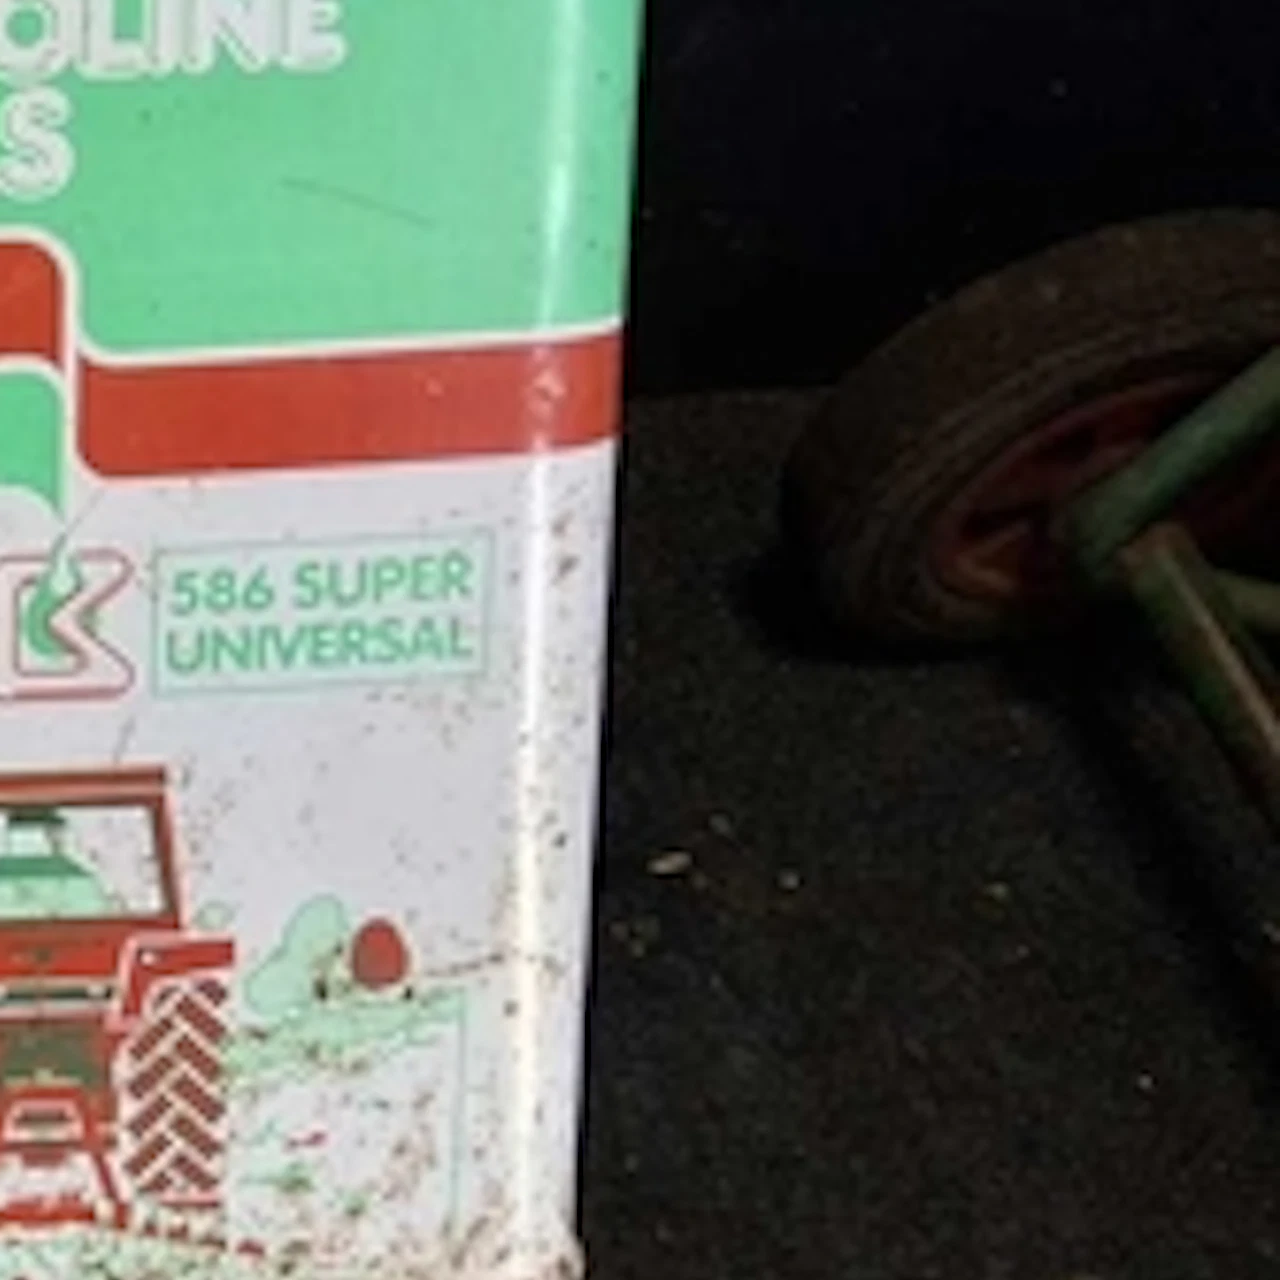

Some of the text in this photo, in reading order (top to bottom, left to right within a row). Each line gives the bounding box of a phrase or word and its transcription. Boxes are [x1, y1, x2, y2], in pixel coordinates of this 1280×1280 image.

[172, 549, 475, 617] 586 SUPER
[165, 616, 474, 674] UNIVERSAL
